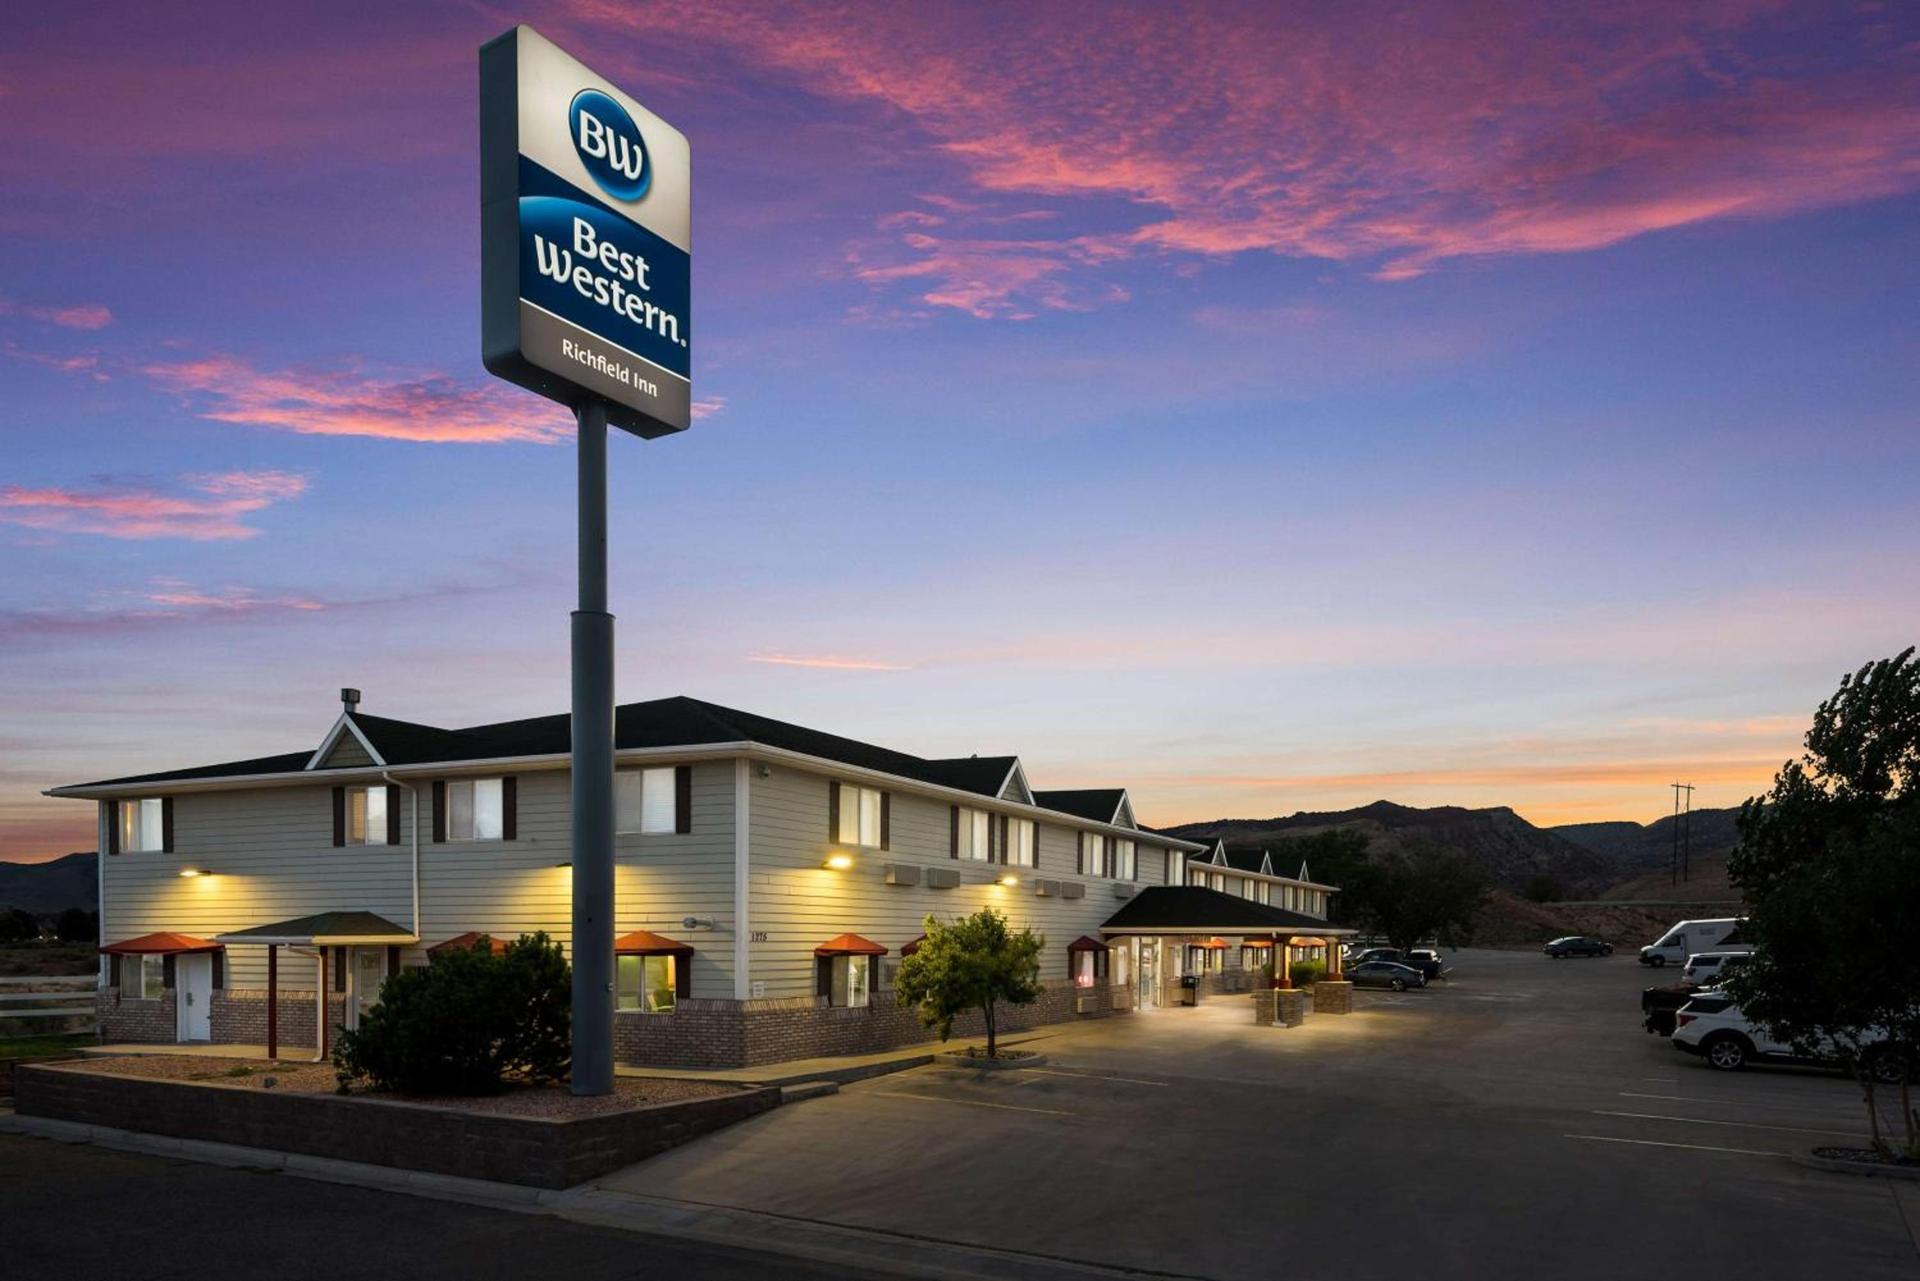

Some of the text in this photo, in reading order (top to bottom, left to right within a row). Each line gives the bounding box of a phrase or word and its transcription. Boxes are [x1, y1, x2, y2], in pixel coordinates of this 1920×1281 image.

[578, 109, 643, 181] BW
[573, 216, 650, 291] Best
[562, 338, 658, 398] Richfield Inn
